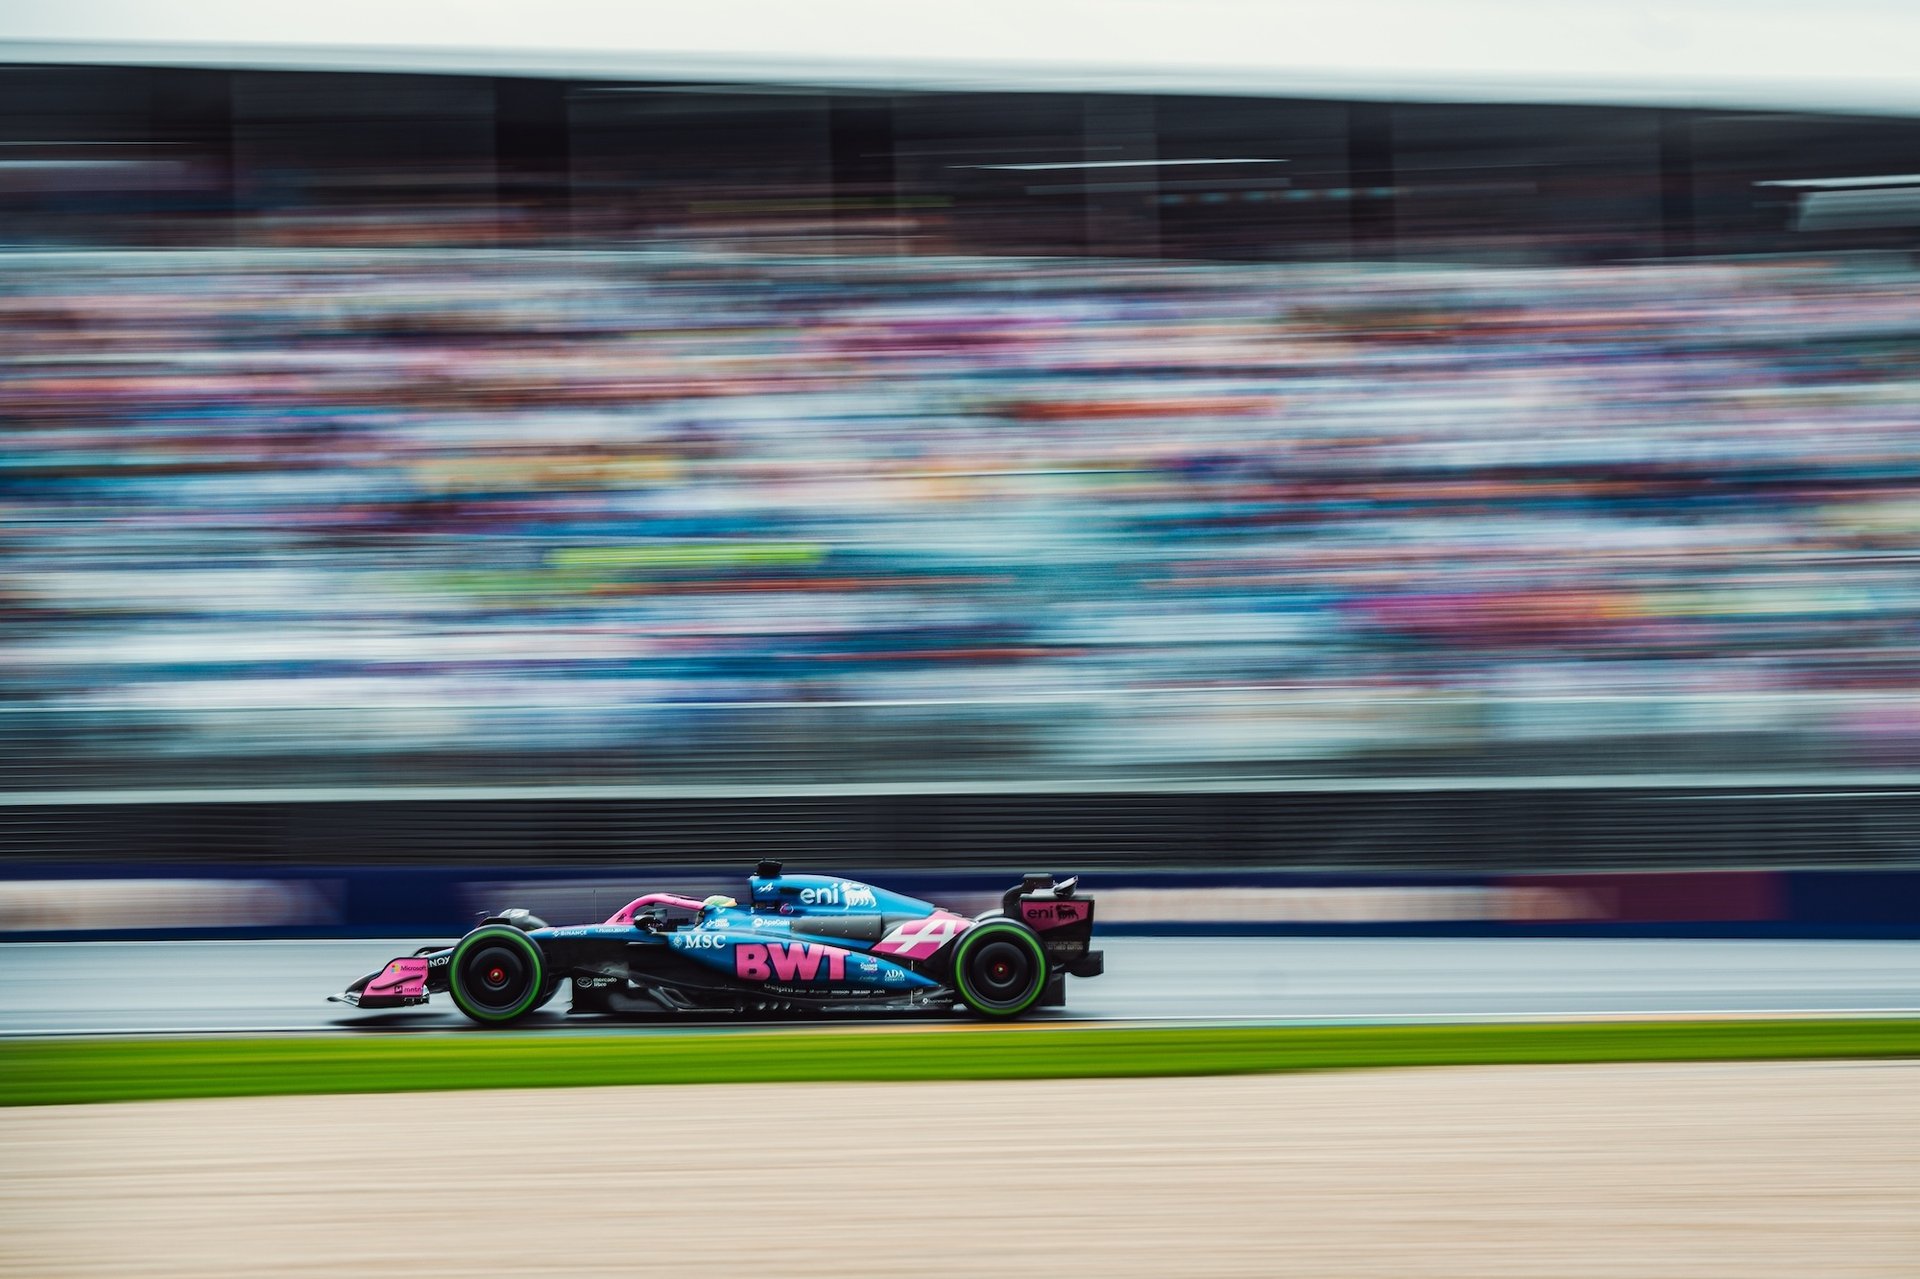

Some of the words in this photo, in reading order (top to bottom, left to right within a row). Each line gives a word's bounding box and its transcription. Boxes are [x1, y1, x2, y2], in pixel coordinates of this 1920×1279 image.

[800, 883, 838, 904] eni
[1027, 906, 1053, 918] eni
[685, 934, 726, 949] MSC
[736, 942, 852, 981] BWT
[885, 969, 905, 978] ADA
